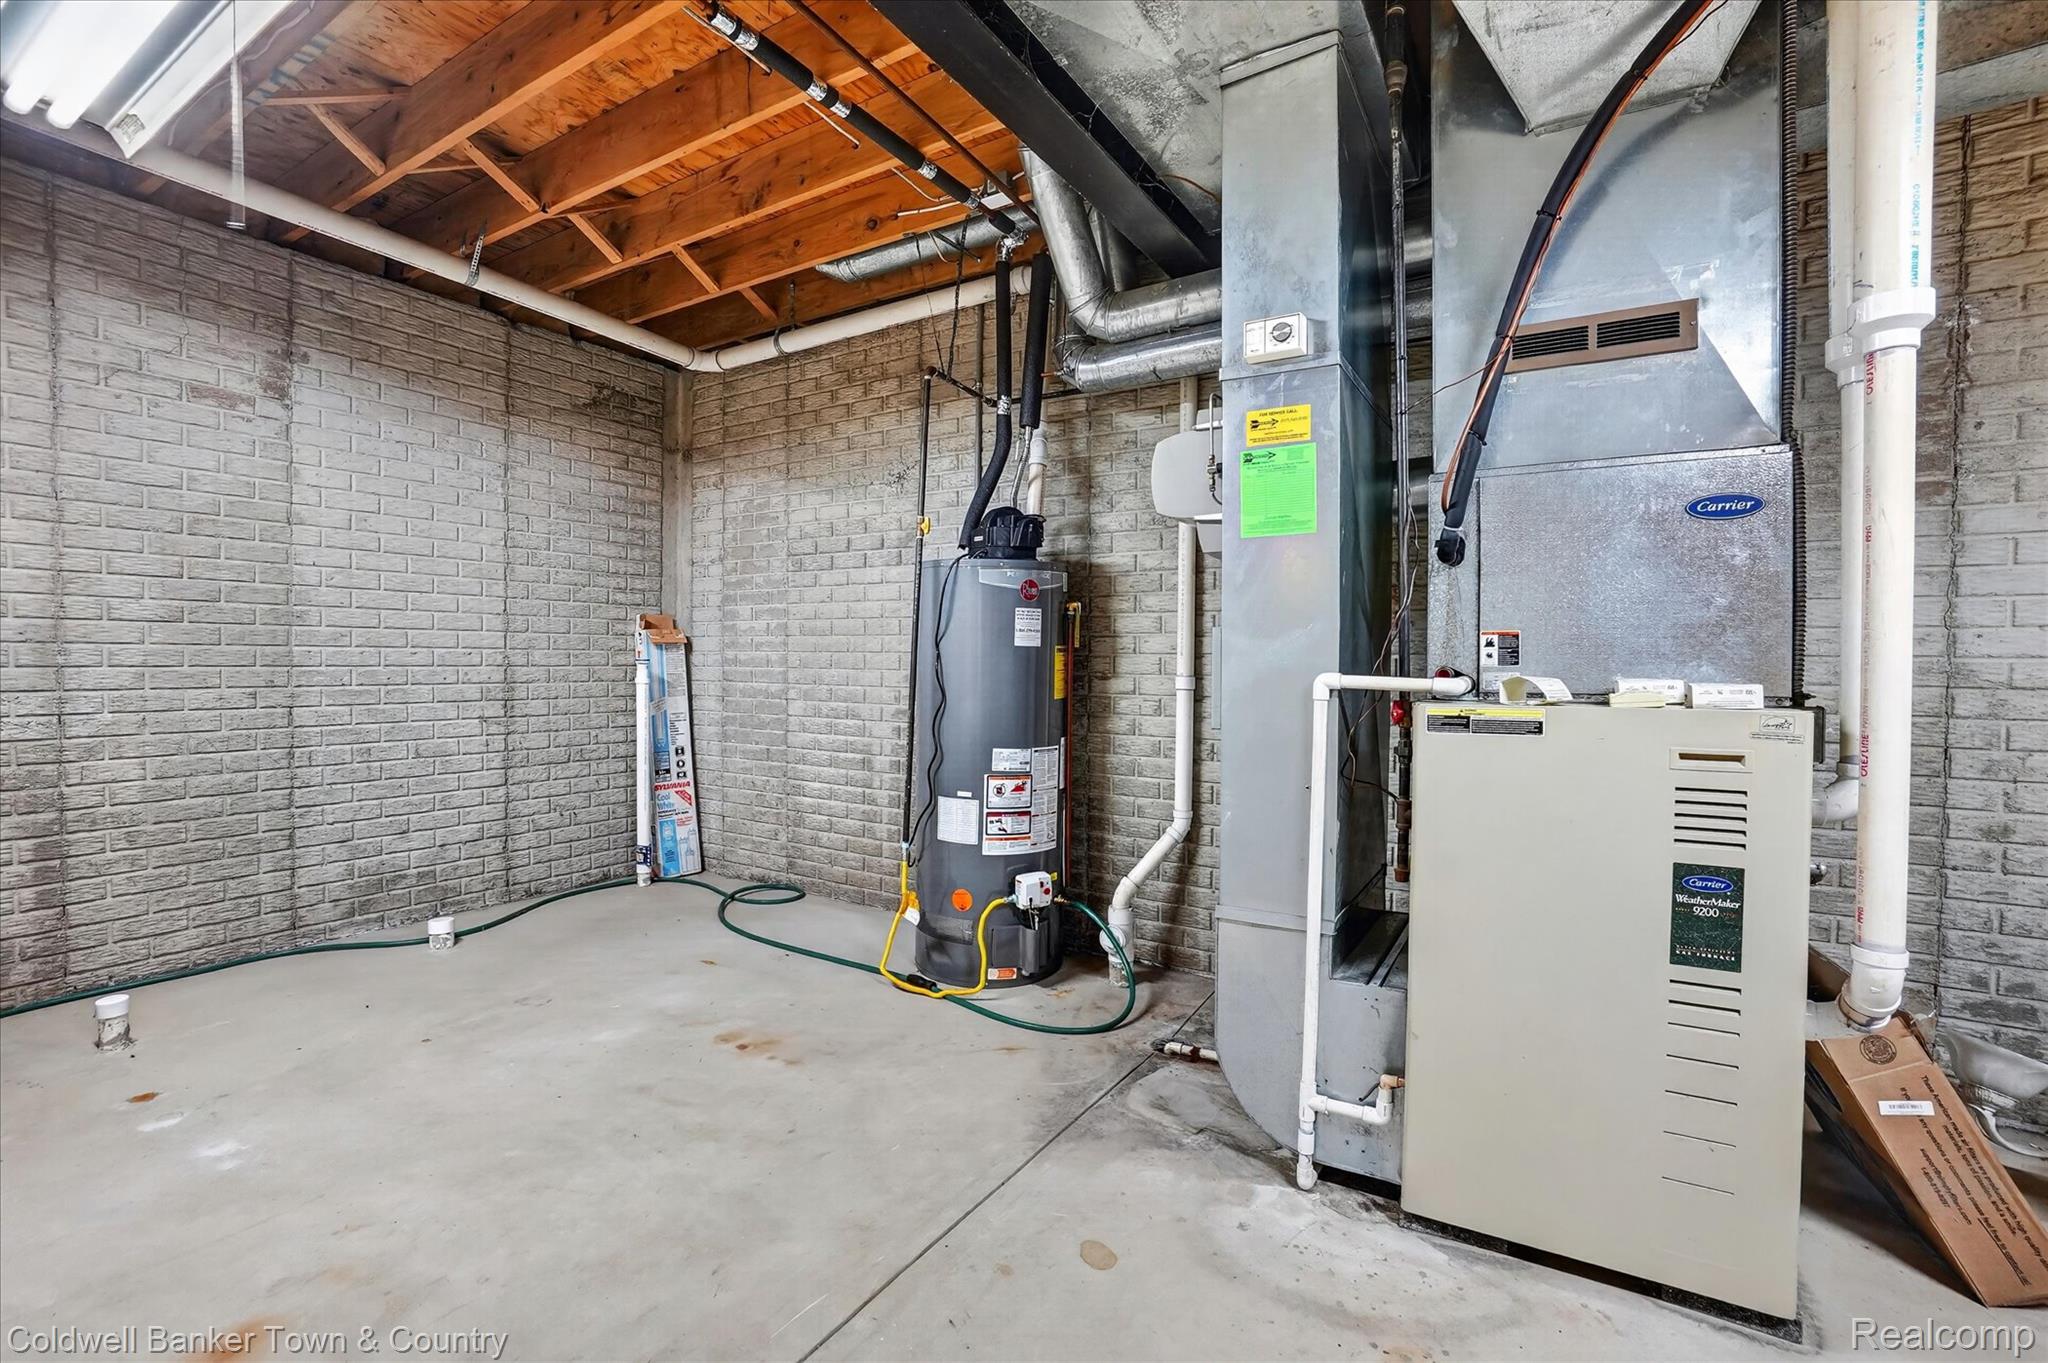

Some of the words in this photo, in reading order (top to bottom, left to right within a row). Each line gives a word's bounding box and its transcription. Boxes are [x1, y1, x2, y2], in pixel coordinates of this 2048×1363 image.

[1697, 500, 1755, 512] Carrier
[654, 781, 691, 791] SYLVANIA
[656, 793, 671, 801] Cool
[1689, 878, 1727, 889] Carrier
[1675, 893, 1741, 909] WeatherMaker
[1693, 906, 1719, 917] 9200
